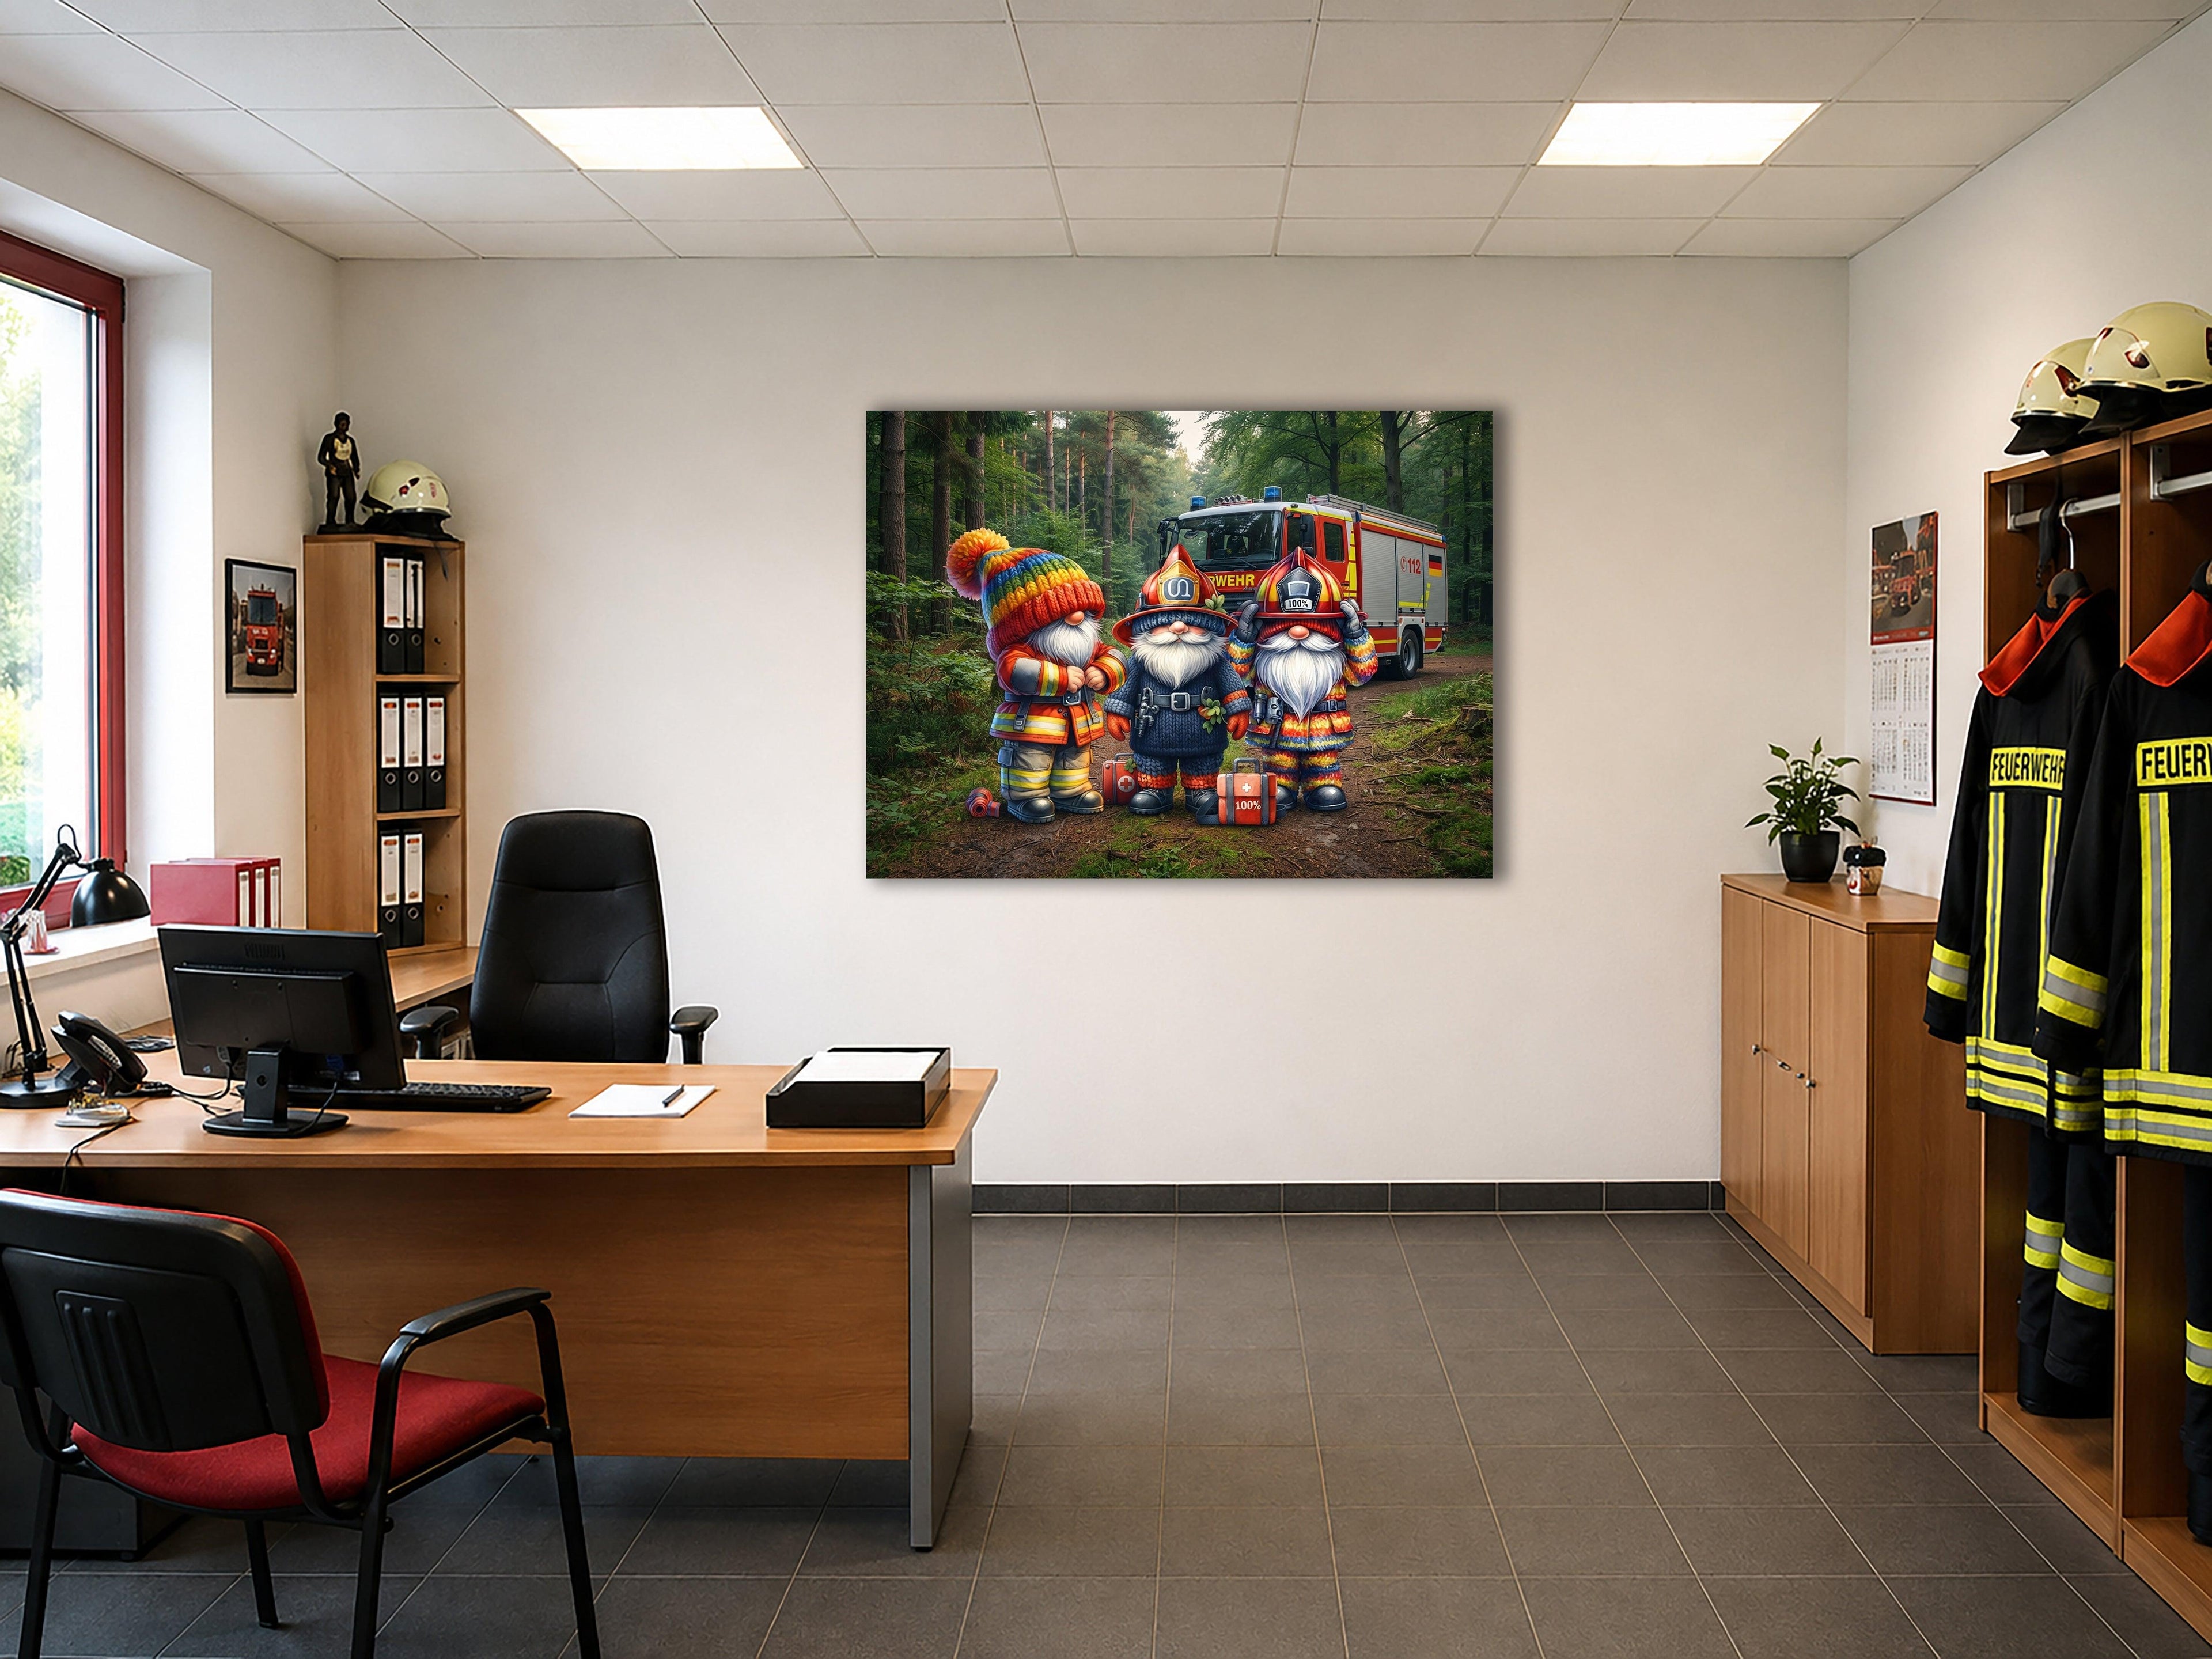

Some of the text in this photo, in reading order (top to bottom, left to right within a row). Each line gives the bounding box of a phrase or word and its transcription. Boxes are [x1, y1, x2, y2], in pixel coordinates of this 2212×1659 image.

[1407, 558, 1421, 574] 112
[1289, 600, 1308, 608] 100%
[1235, 800, 1262, 810] 100%
